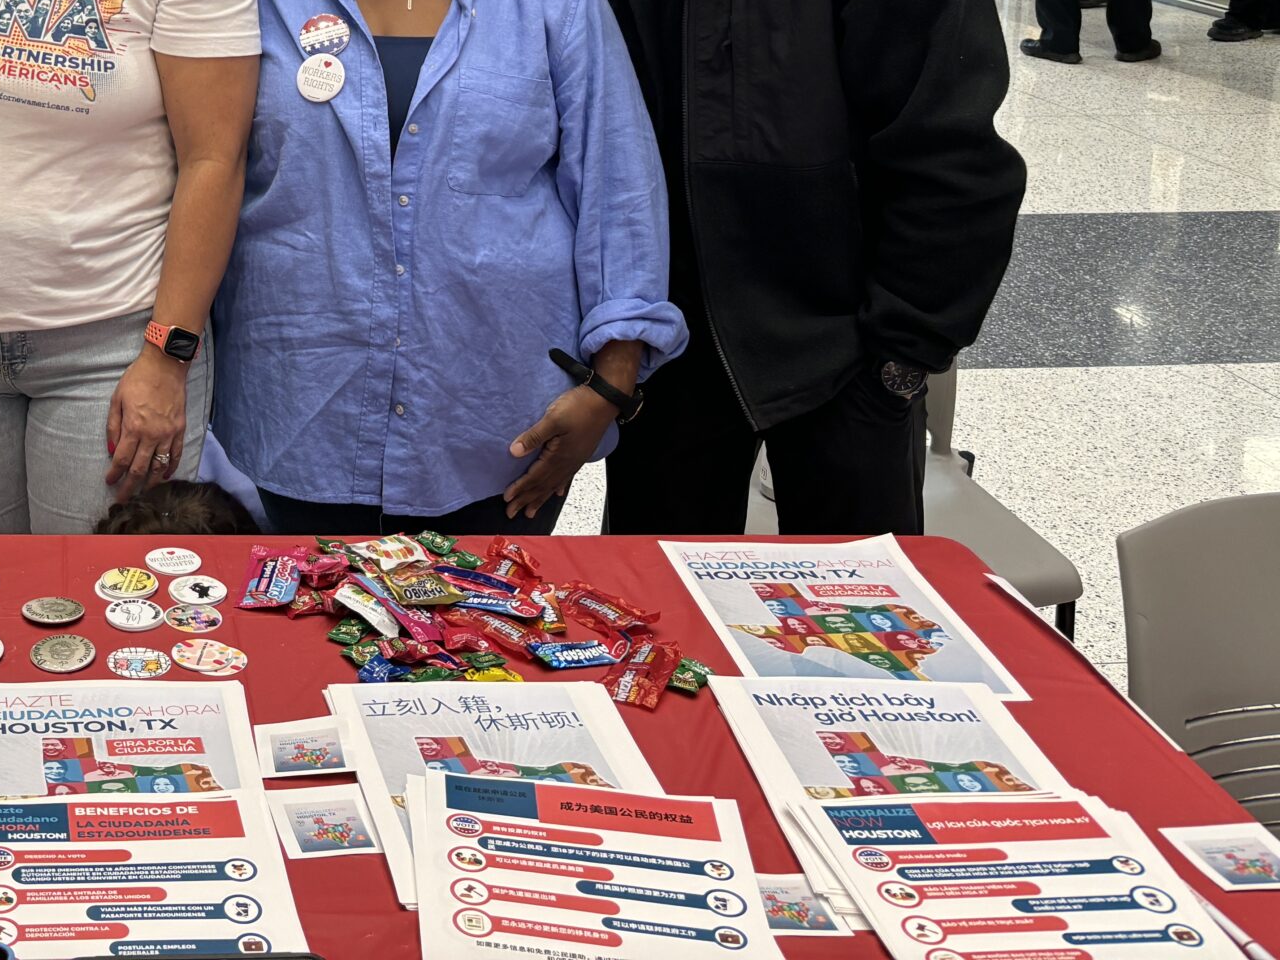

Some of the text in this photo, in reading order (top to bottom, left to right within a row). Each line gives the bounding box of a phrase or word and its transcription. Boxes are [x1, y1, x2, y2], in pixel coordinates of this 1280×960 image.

[302, 65, 342, 84] WORKERS
[304, 77, 334, 93] RIGHTS
[148, 554, 196, 563] WORKERS
[680, 550, 760, 563] ¡HAZTE
[159, 560, 194, 568] RIGHTS
[695, 569, 863, 583] HOUSTON, TX
[403, 587, 448, 600] HARIBO
[555, 644, 609, 662] AIRHEADS
[751, 692, 936, 709] Nhập tịch bây
[814, 708, 982, 726] giờ Houston!
[140, 718, 178, 731] TX
[114, 740, 143, 748] GIRA
[145, 739, 170, 747] POR
[115, 744, 196, 754] CIUDADANÍA
[74, 806, 199, 817] BENEFICIOS DE
[559, 801, 694, 825] 成为美国公民的权益
[829, 809, 914, 818] NATURALIZE
[75, 817, 191, 828] LA CIUDADANÍA
[833, 817, 884, 828] NOW
[1050, 817, 1076, 825] HOA
[7, 832, 68, 840] HOUSTON!
[77, 827, 211, 838] ESTADOUNIDENSE
[842, 829, 922, 839] HOUSTON!
